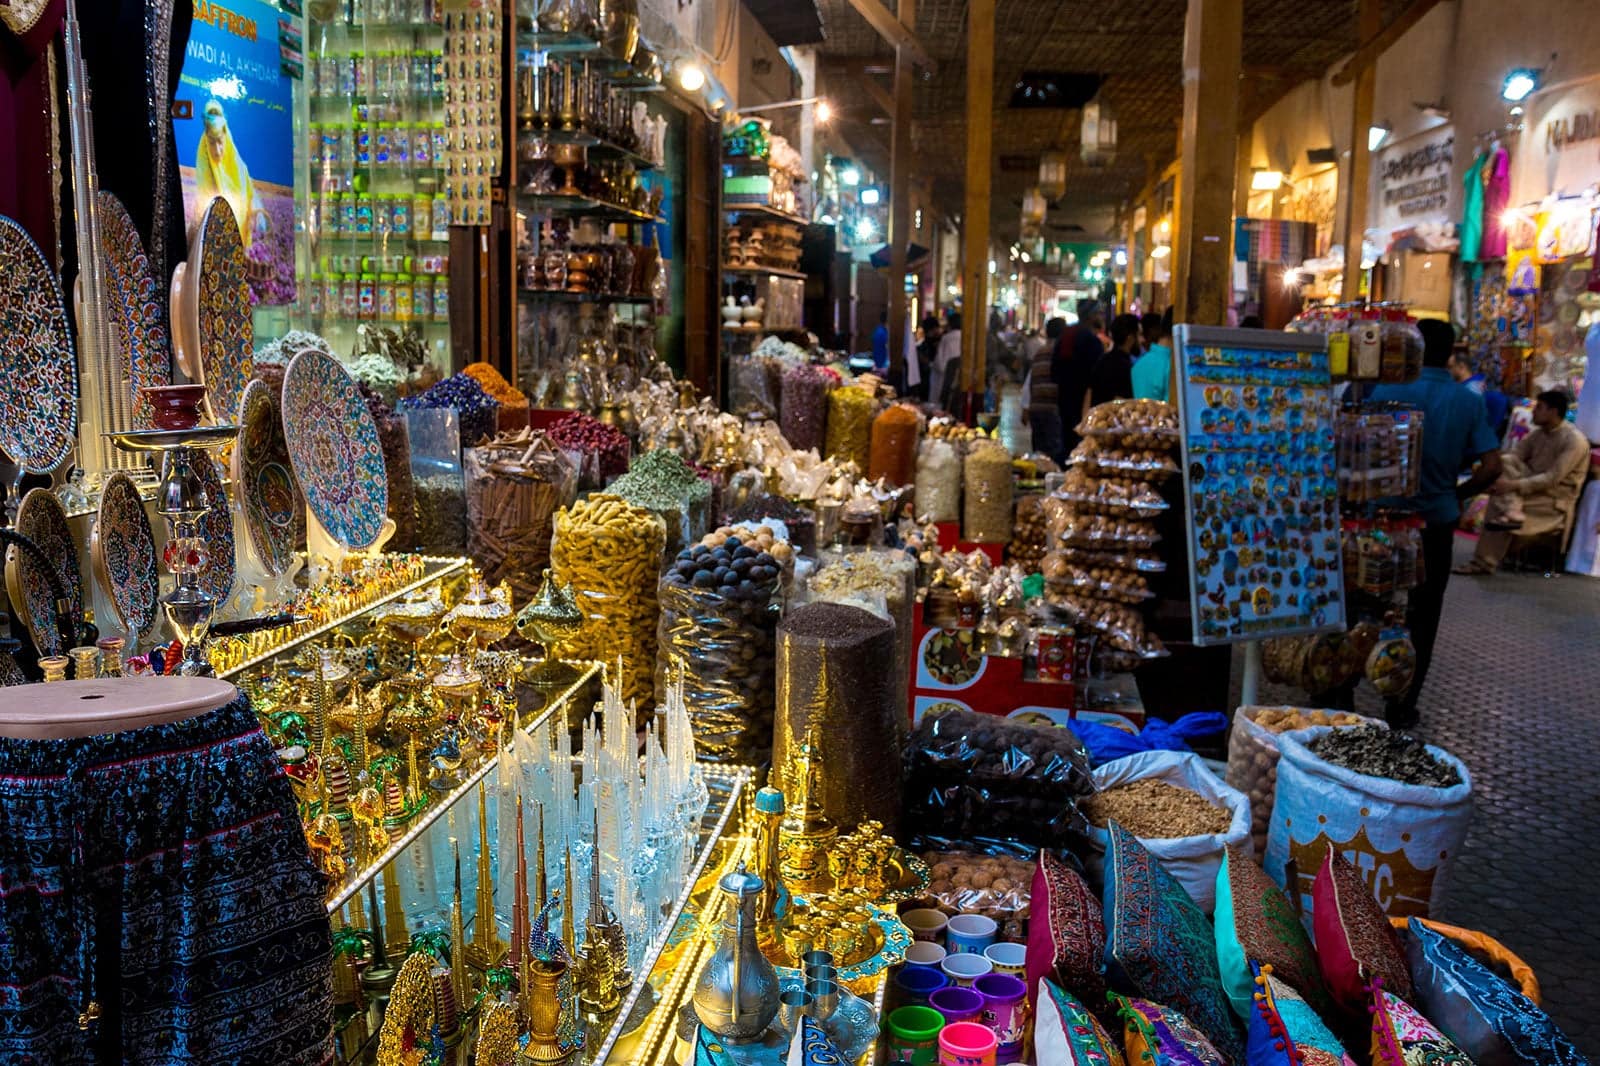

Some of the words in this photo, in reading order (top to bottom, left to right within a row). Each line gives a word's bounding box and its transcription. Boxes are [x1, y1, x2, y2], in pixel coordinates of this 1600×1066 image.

[193, 0, 257, 42] SAFFRON
[187, 39, 217, 65] WADI
[220, 50, 233, 71] AL
[237, 56, 280, 87] AKHDAR
